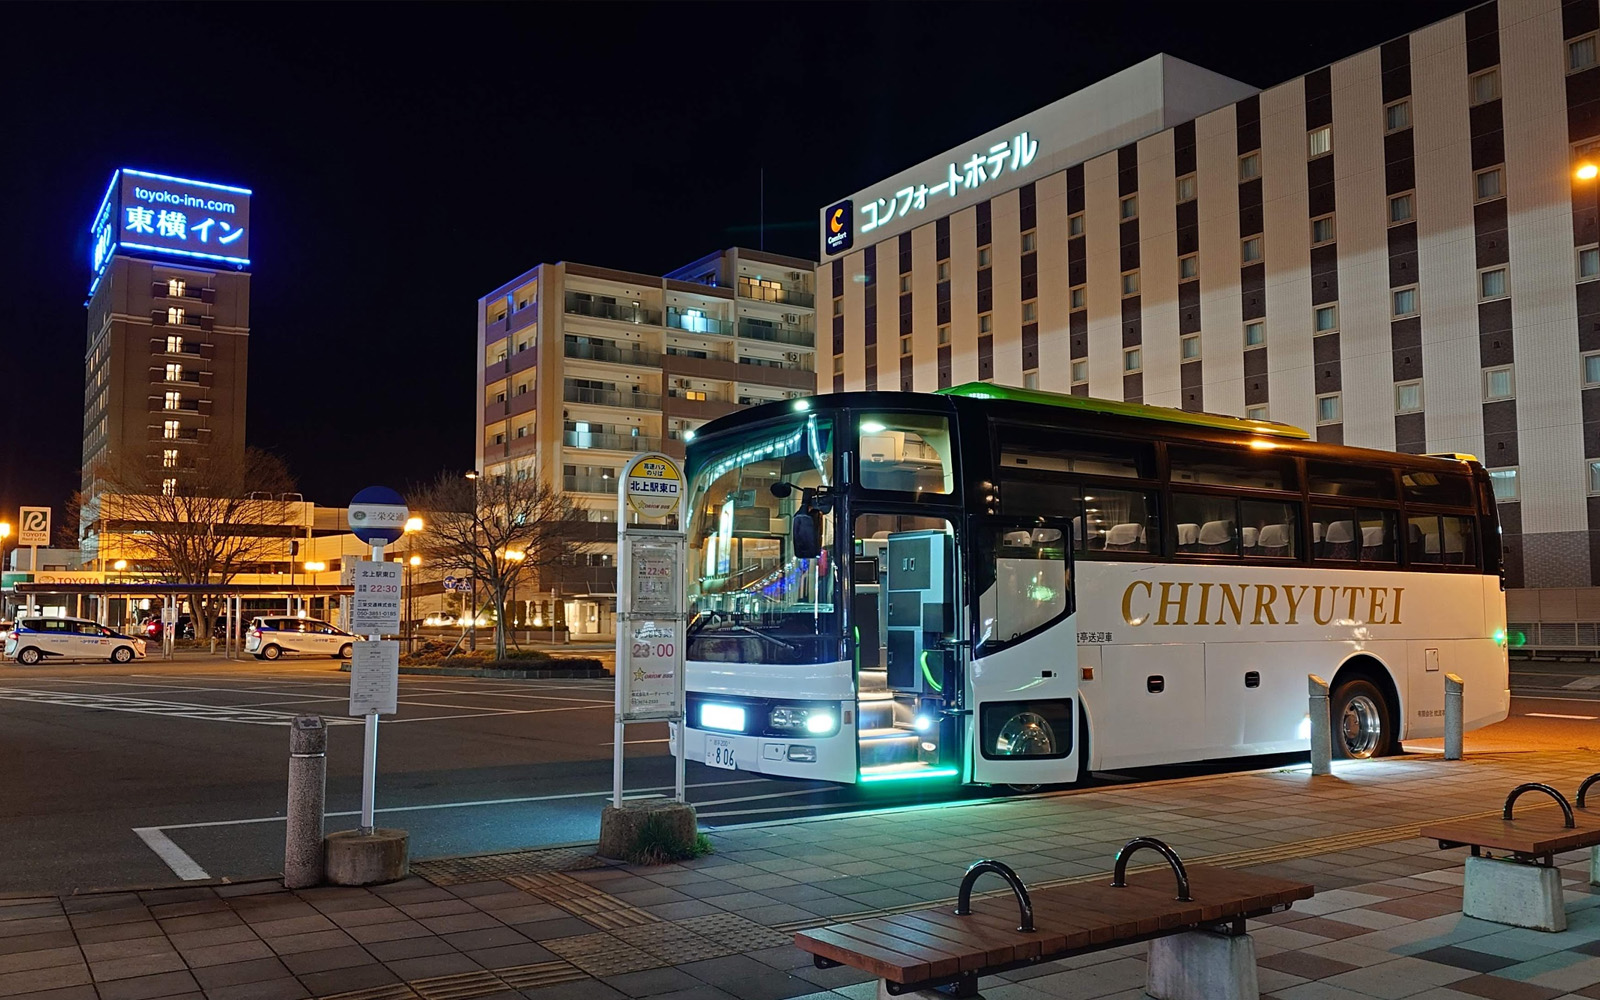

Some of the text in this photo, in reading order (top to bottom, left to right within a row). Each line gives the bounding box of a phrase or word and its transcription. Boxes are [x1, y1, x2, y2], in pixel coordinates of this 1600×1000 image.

[861, 132, 1038, 233] コンフォートホテル
[135, 187, 235, 213] toyoko-inn.com
[126, 206, 243, 244] 東横イン
[631, 481, 677, 493] 北上駅東口
[368, 511, 404, 521] 三栄交通
[370, 584, 398, 593] 22:30
[1121, 580, 1405, 627] CHINRYUTEI
[632, 643, 674, 658] 23:00
